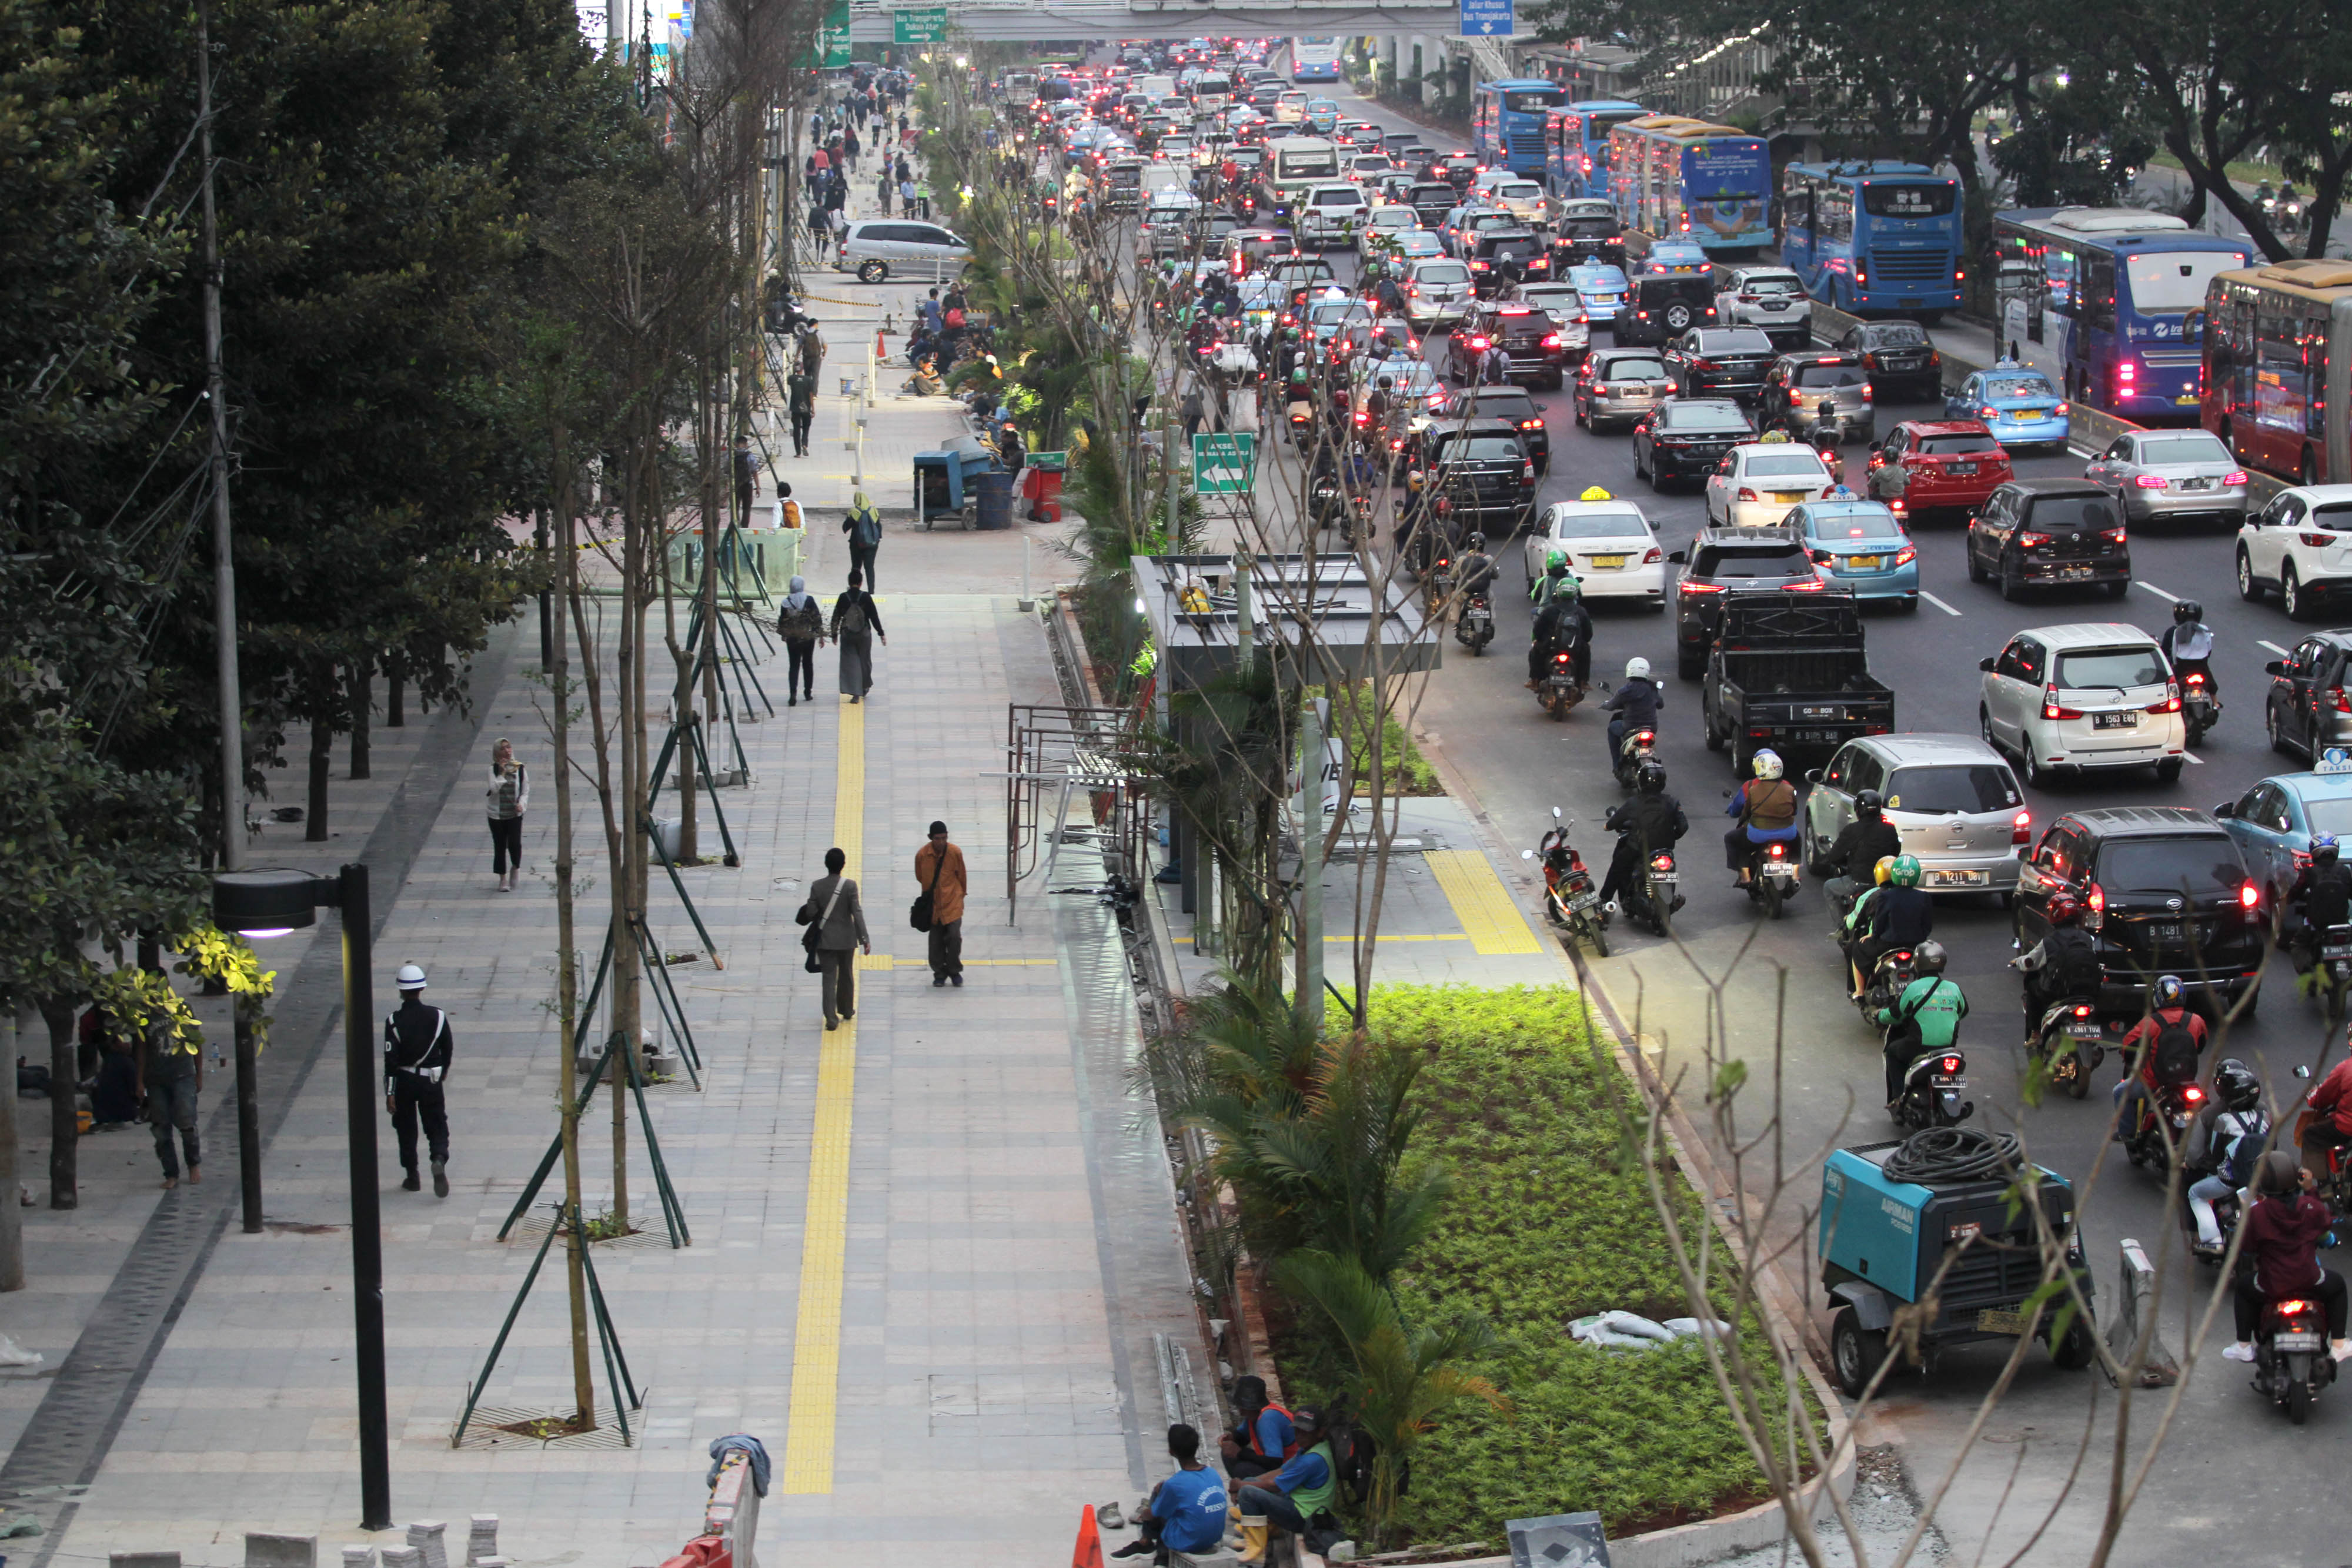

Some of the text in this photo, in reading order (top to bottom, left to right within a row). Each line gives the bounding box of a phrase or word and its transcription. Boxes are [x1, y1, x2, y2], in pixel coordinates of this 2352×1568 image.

[1468, 0, 1505, 9] Jalur Khusus
[1463, 12, 1474, 21] Bus
[2095, 716, 2100, 724] B
[2105, 714, 2120, 723] 1563
[1895, 868, 1916, 877] Grab
[1935, 872, 1940, 881] B
[1946, 872, 1963, 881] 1211
[2150, 926, 2156, 936] B
[2161, 925, 2180, 936] 1481
[385, 1041, 392, 1052] D
[1882, 1198, 1915, 1225] AIRMAN
